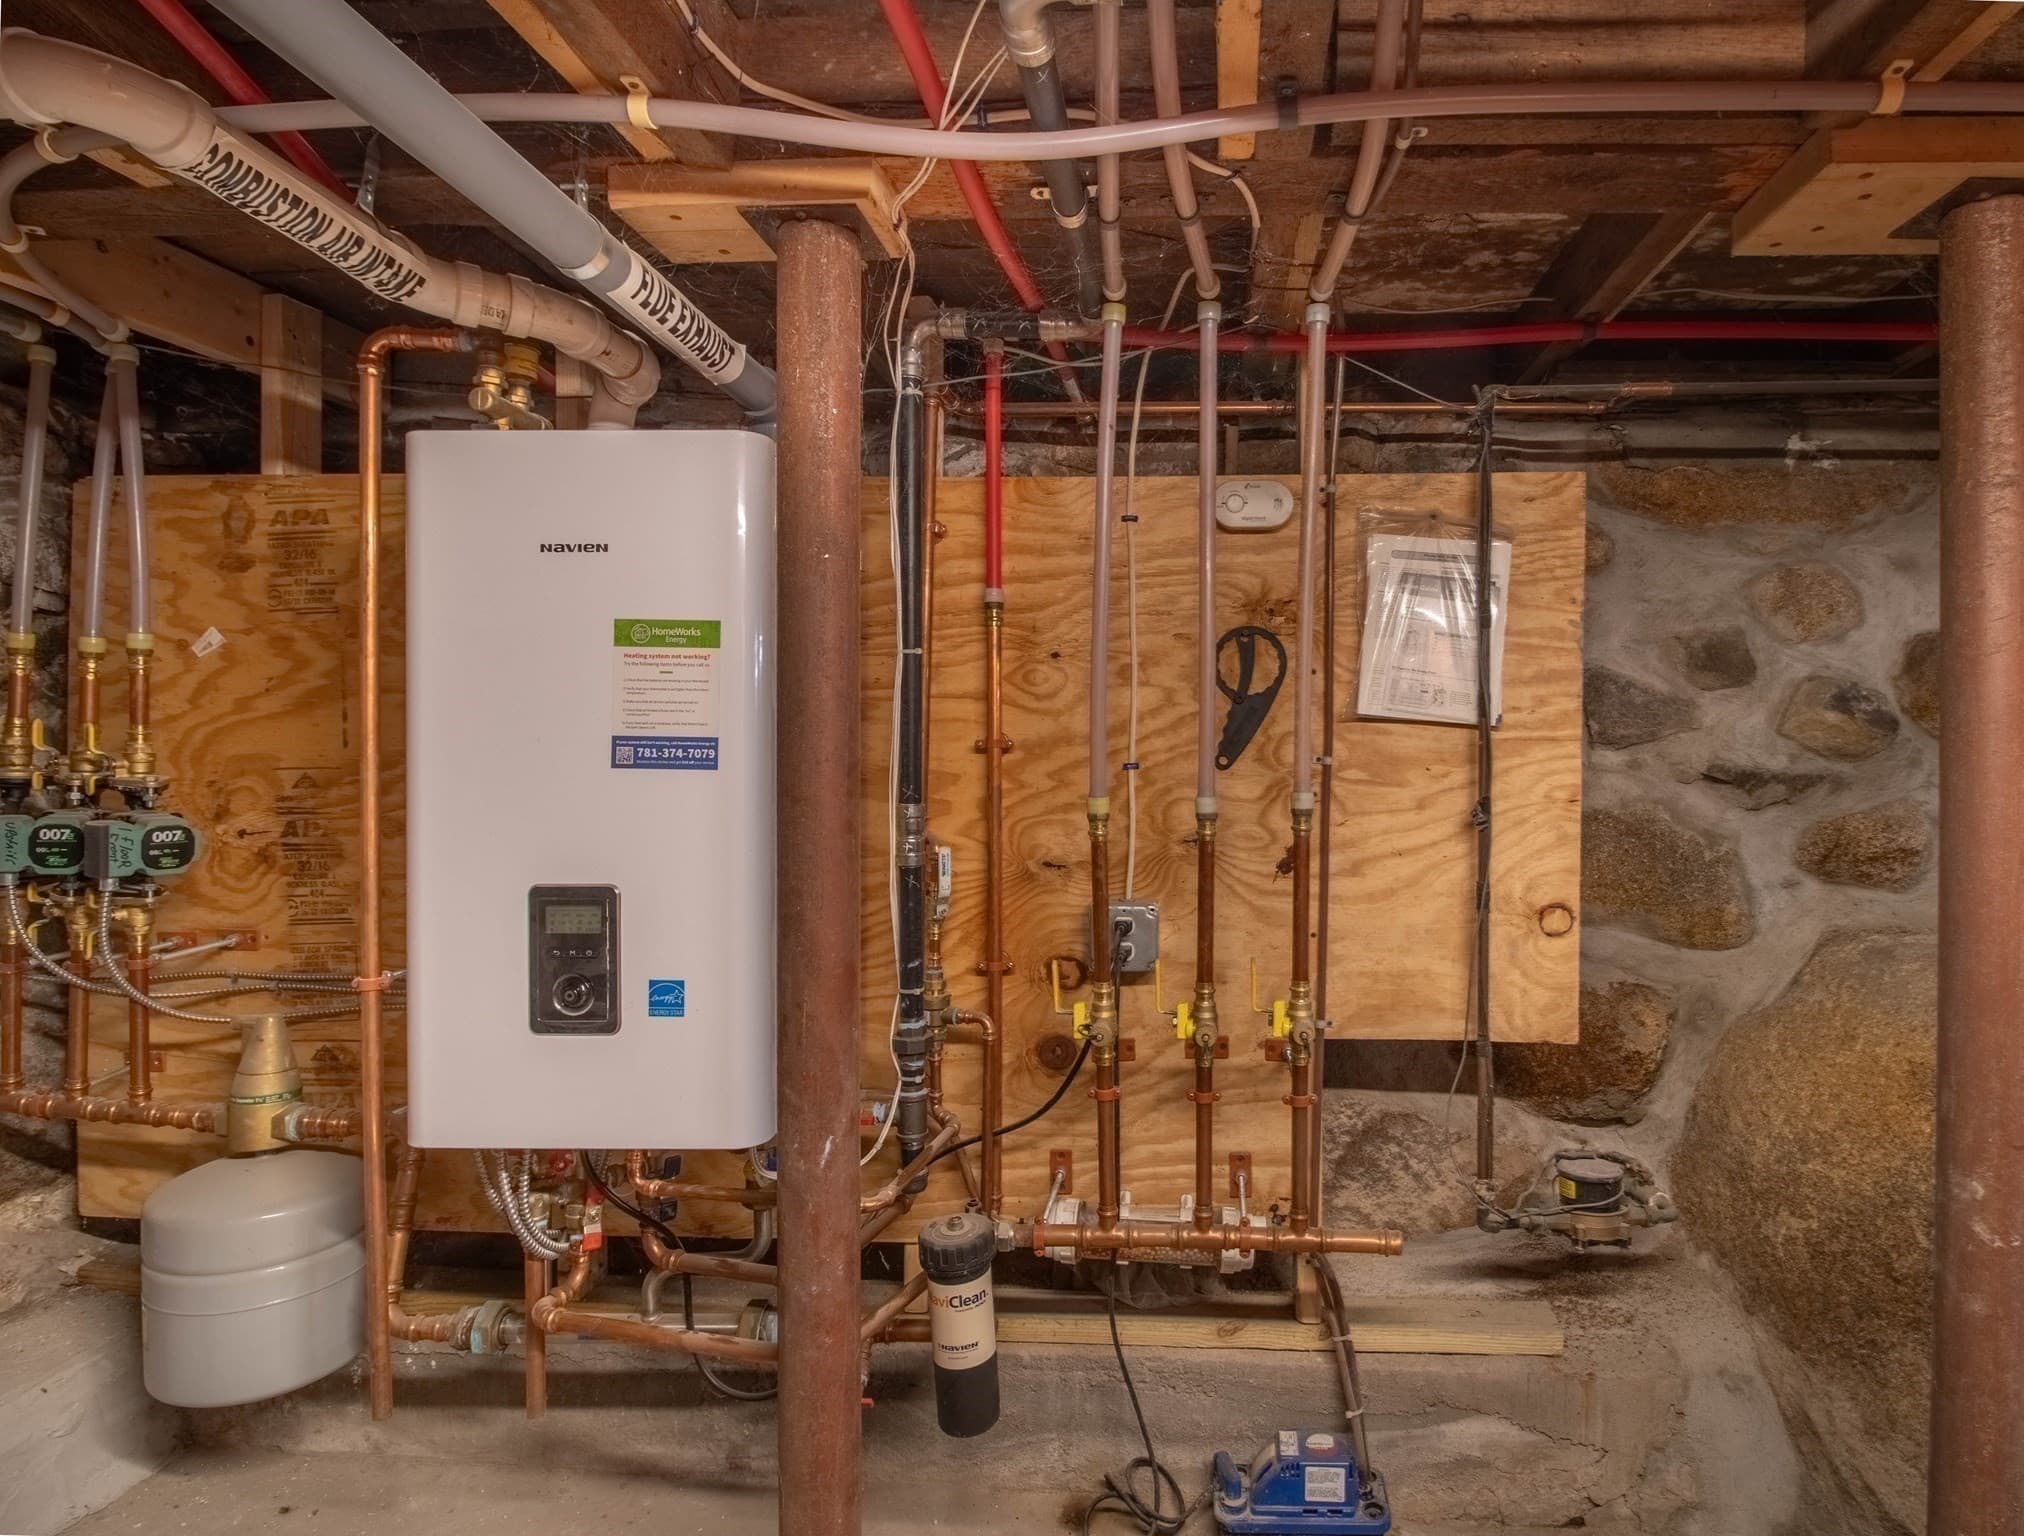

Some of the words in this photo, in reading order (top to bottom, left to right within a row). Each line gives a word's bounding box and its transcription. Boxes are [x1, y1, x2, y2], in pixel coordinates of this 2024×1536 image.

[181, 143, 334, 244] COMBUSTION
[316, 226, 366, 268] AIR
[350, 246, 427, 301] INTAKE
[630, 264, 678, 326] FLUE
[667, 297, 736, 374] EXHAUST
[268, 509, 329, 527] APA
[651, 626, 701, 637] HomeWorks
[665, 636, 687, 645] Energy
[623, 652, 648, 661] Heating
[649, 653, 671, 661] system
[683, 653, 711, 661] working?
[637, 747, 716, 759] 781-374-7079
[297, 860, 330, 872] 32/16
[929, 1288, 987, 1309] aviClean
